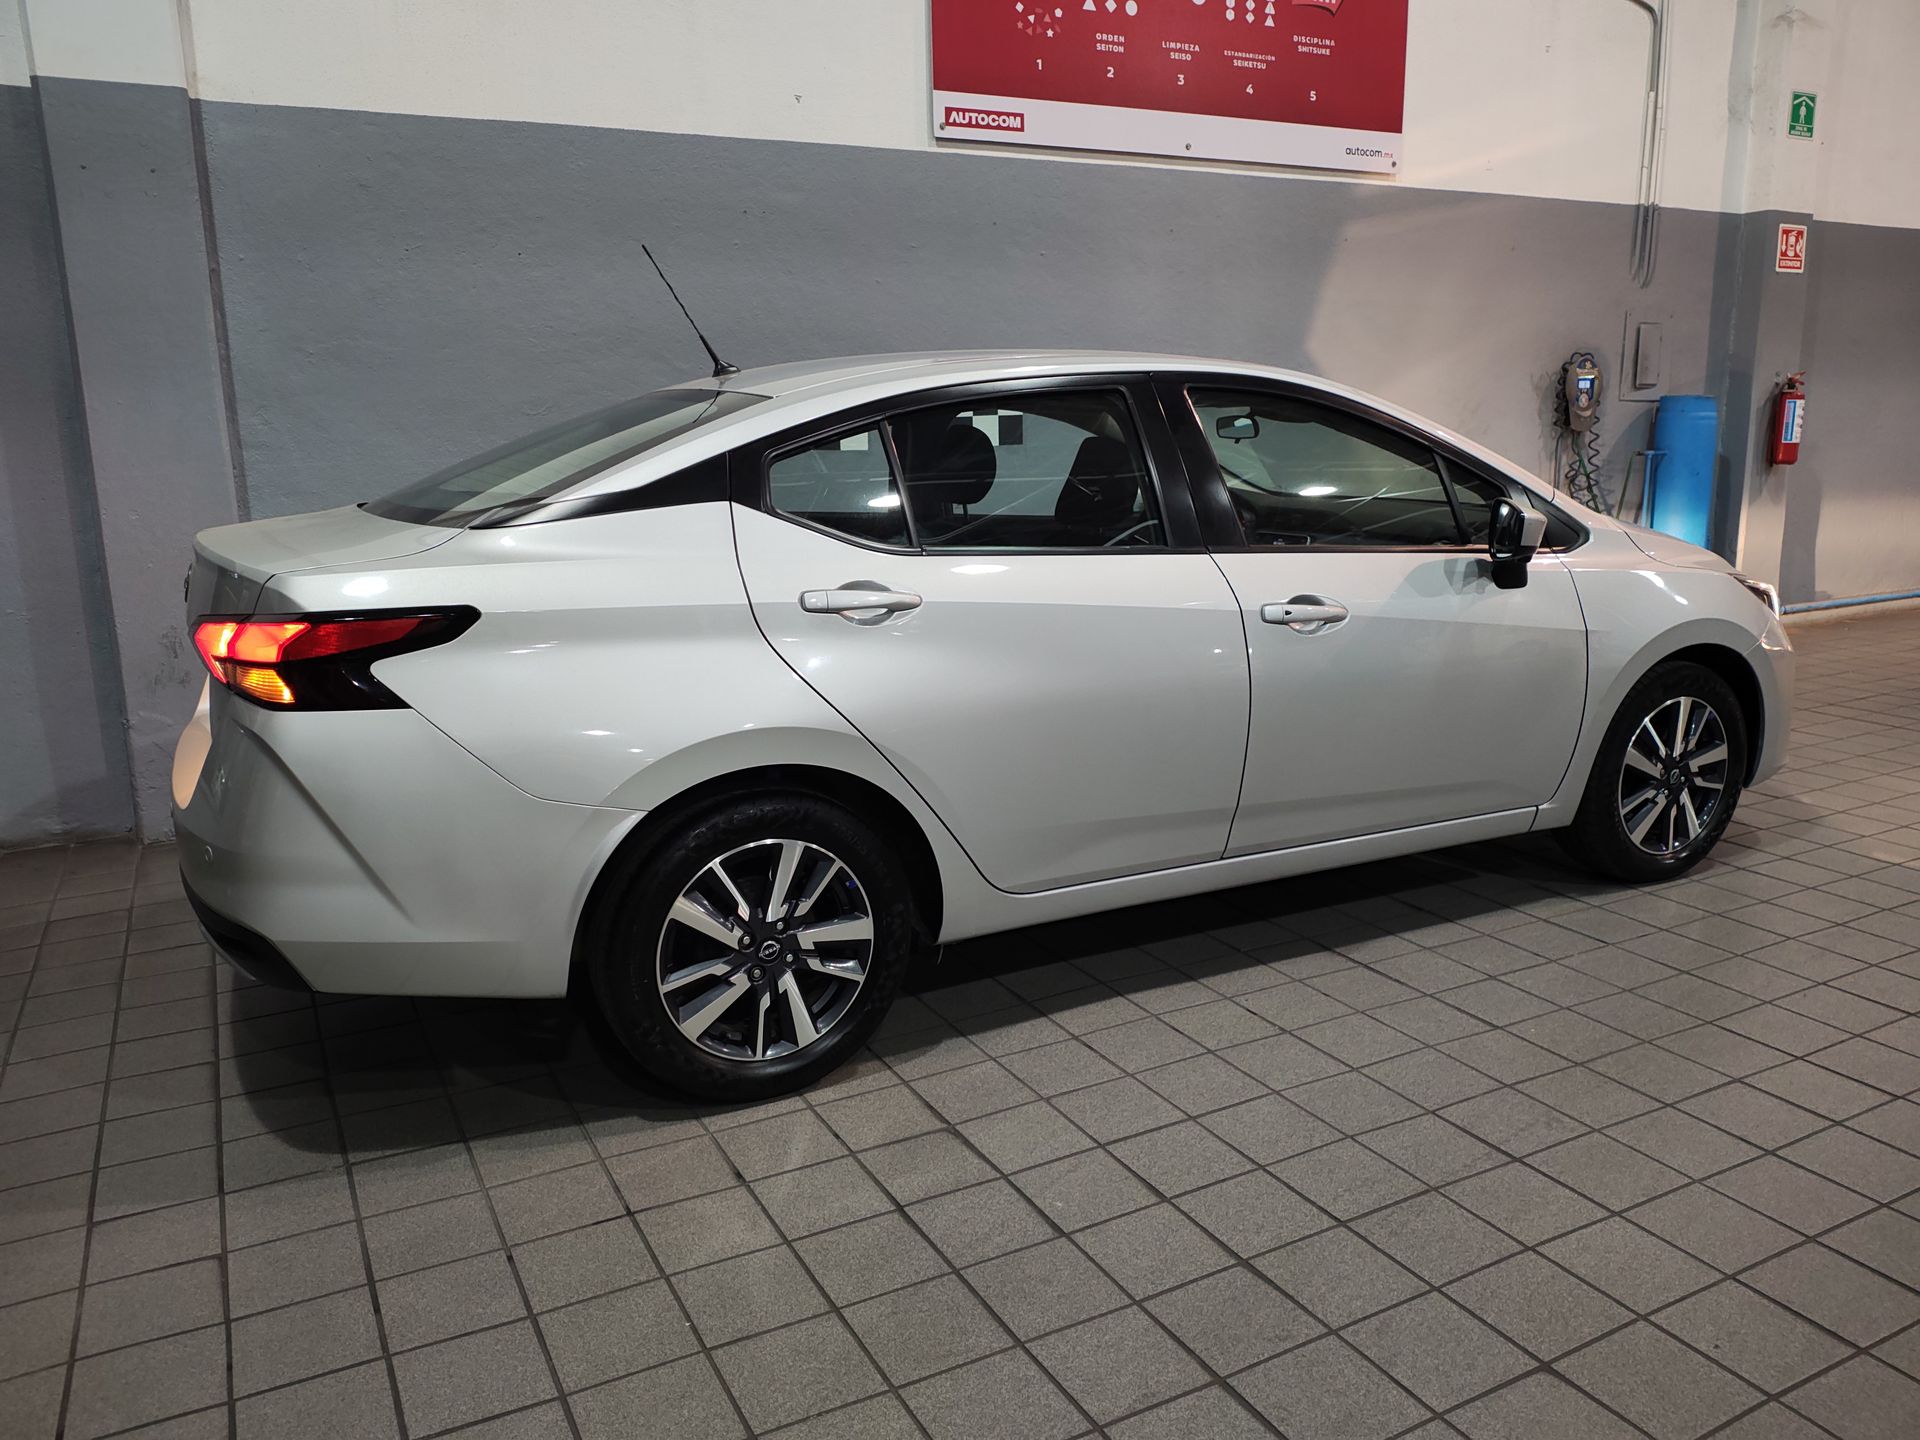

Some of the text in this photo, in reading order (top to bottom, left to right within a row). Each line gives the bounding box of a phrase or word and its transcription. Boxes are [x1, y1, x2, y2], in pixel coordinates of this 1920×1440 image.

[1096, 33, 1125, 43] ORDEN
[1293, 35, 1336, 47] DISCIPLINA
[1096, 43, 1125, 53] SEITON
[1162, 41, 1200, 52] LIMPIEZA
[1298, 45, 1331, 56] SHITSUKE
[1170, 52, 1192, 61] SEISO
[1036, 58, 1042, 70] 1
[1233, 59, 1267, 70] SEIKETSU
[1107, 67, 1114, 77] 2
[1177, 74, 1184, 85] 3
[1246, 84, 1253, 94] 4
[1310, 90, 1316, 101] 5
[948, 111, 1021, 129] AUTOCOM
